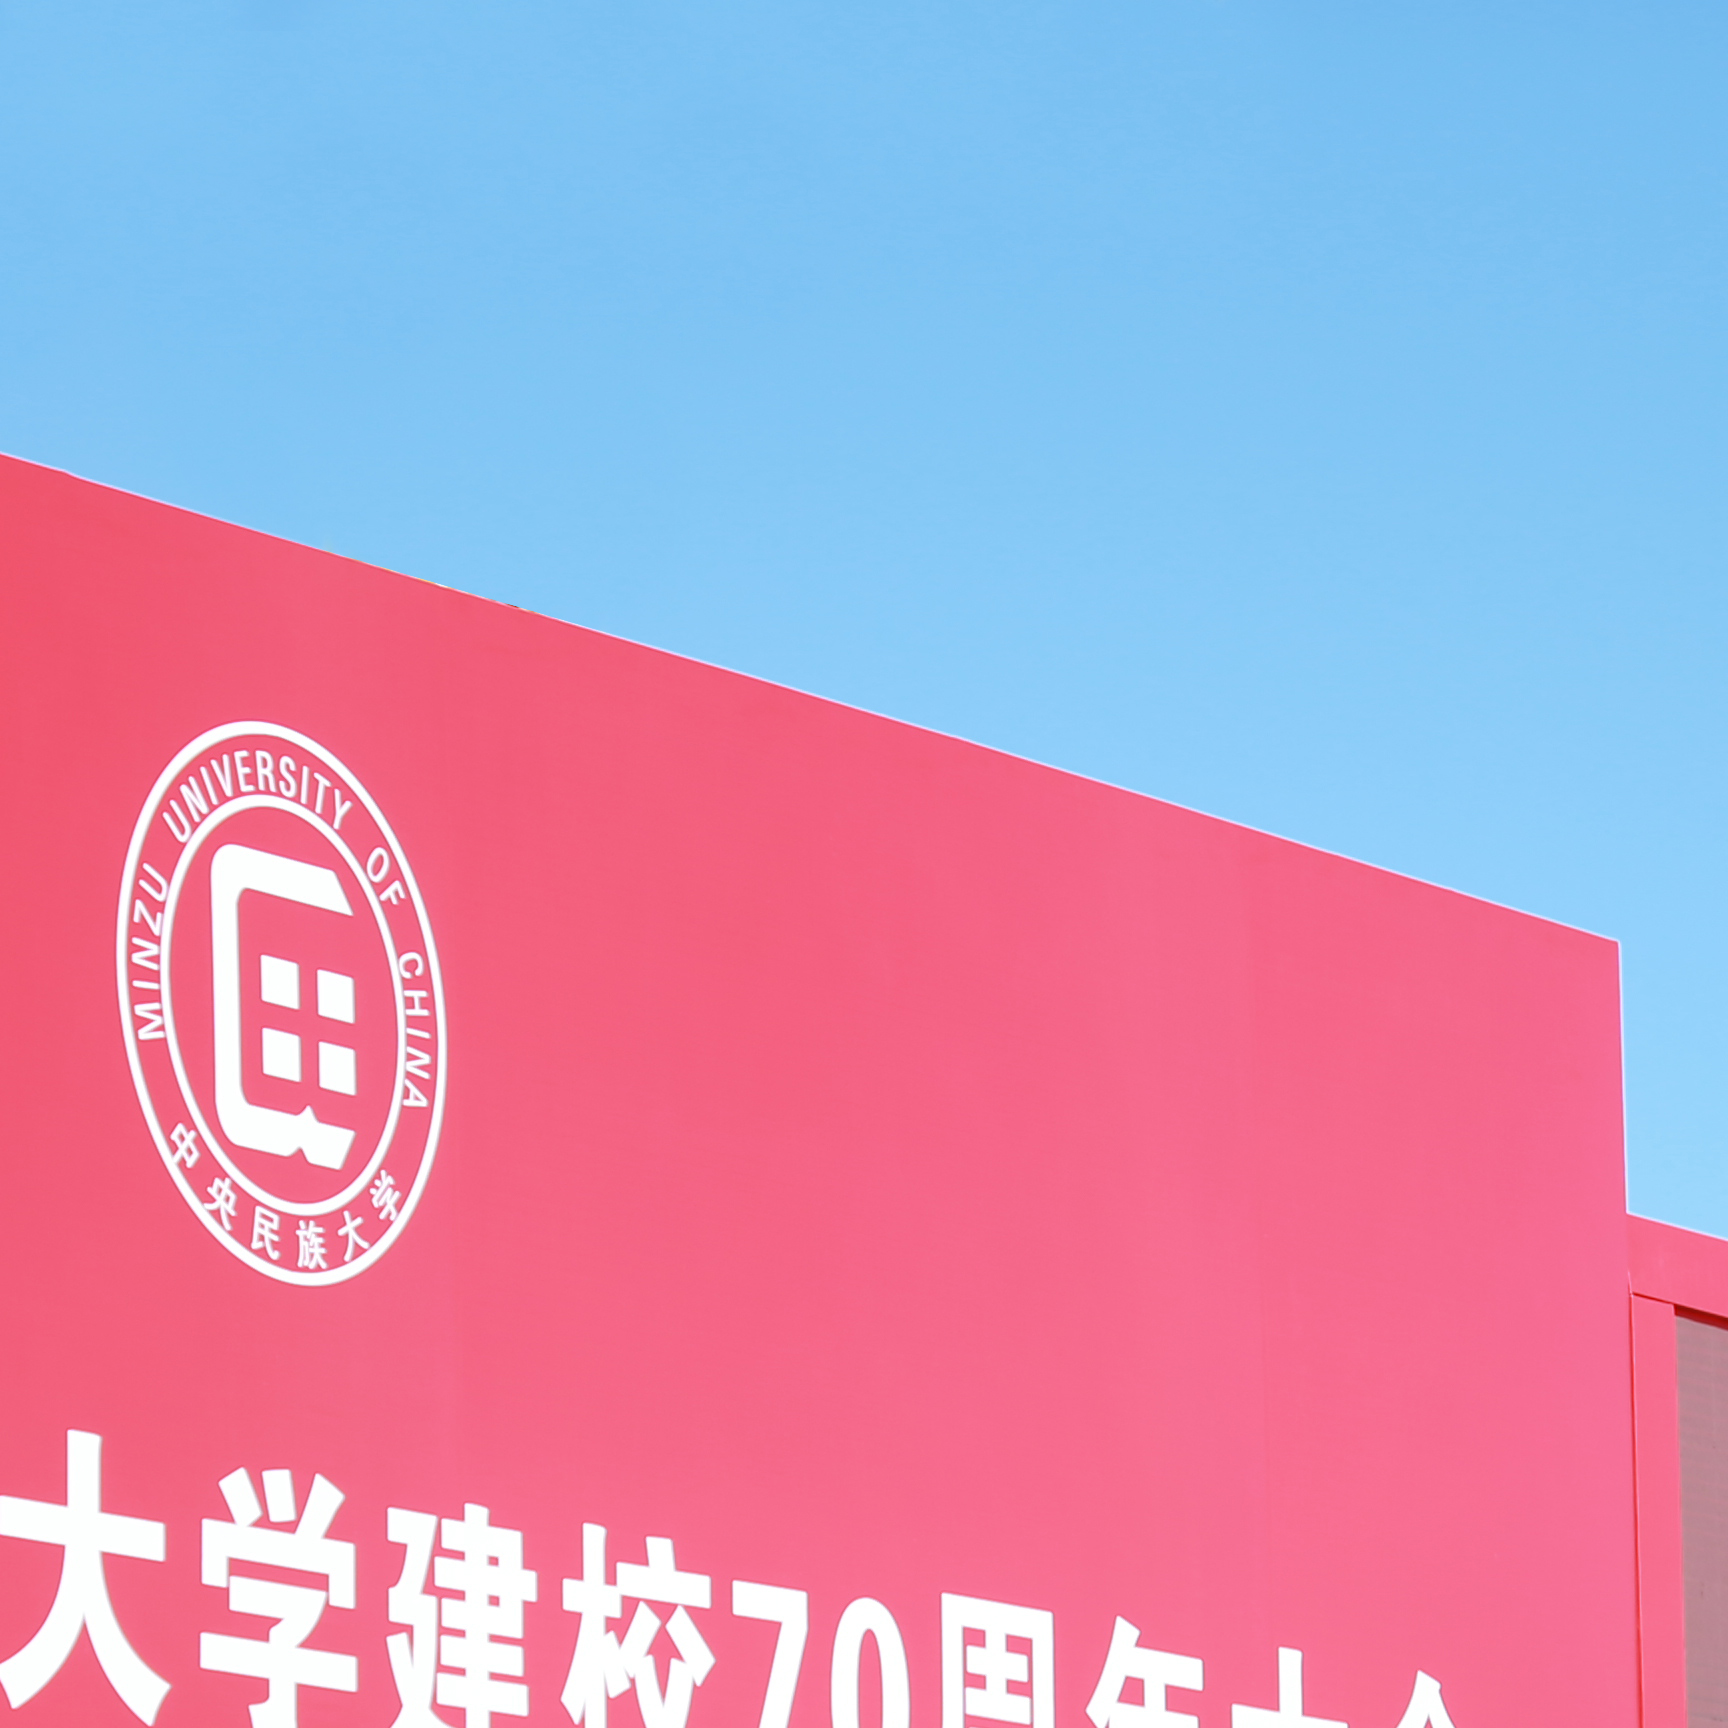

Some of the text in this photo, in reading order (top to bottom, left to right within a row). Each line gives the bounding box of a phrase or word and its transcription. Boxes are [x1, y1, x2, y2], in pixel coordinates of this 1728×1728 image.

[131, 749, 432, 1108] MINZU UNIVERSITY OF CHINA
[170, 1121, 402, 1270] 中央民族大学
